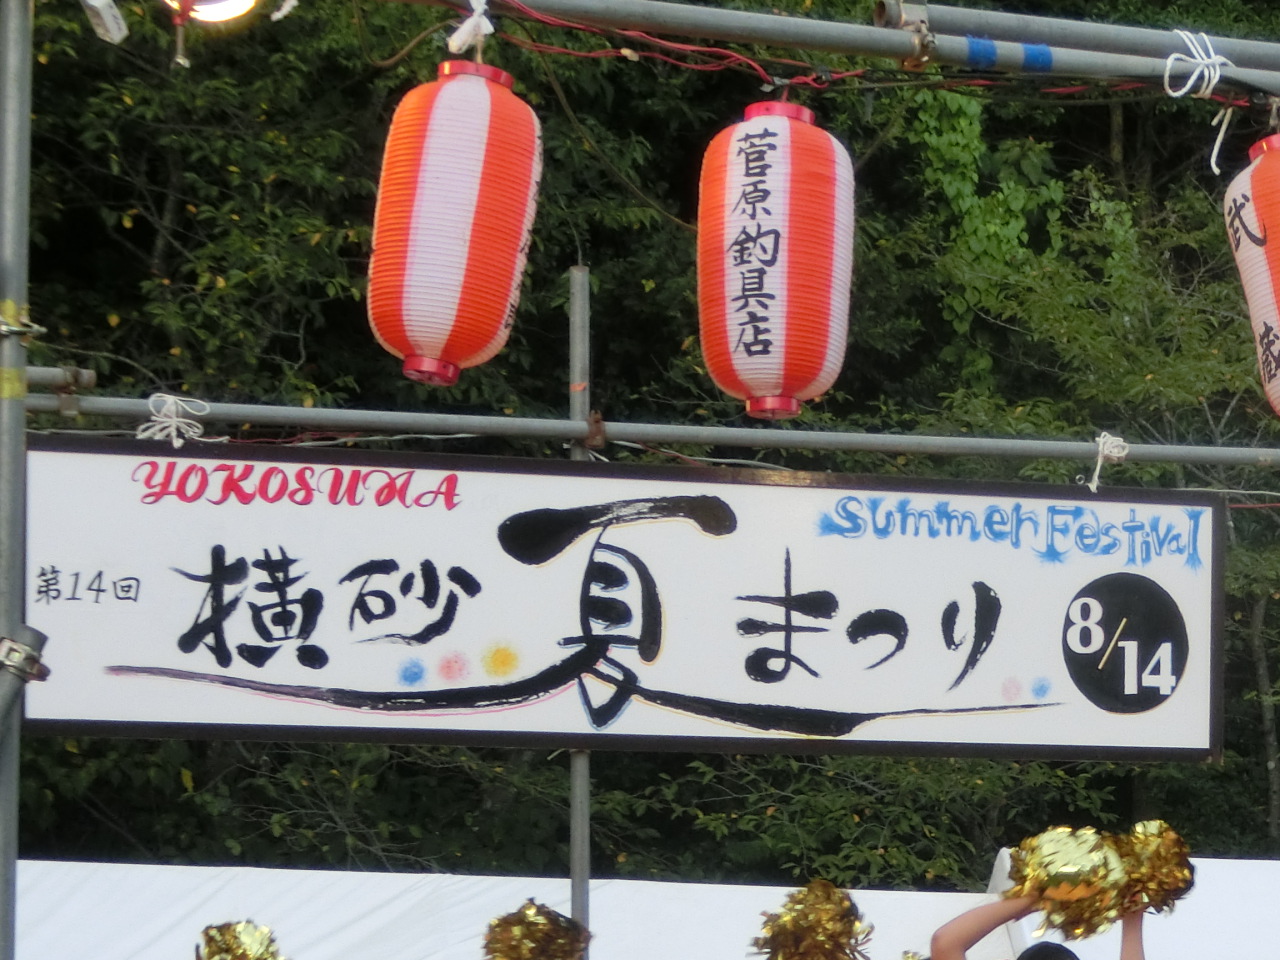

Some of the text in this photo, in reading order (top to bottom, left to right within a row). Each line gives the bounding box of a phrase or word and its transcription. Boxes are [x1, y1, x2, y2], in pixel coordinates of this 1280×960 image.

[726, 127, 781, 358] 菅原釣具店
[34, 565, 141, 603] 第14回
[1065, 596, 1177, 696] 8/14
